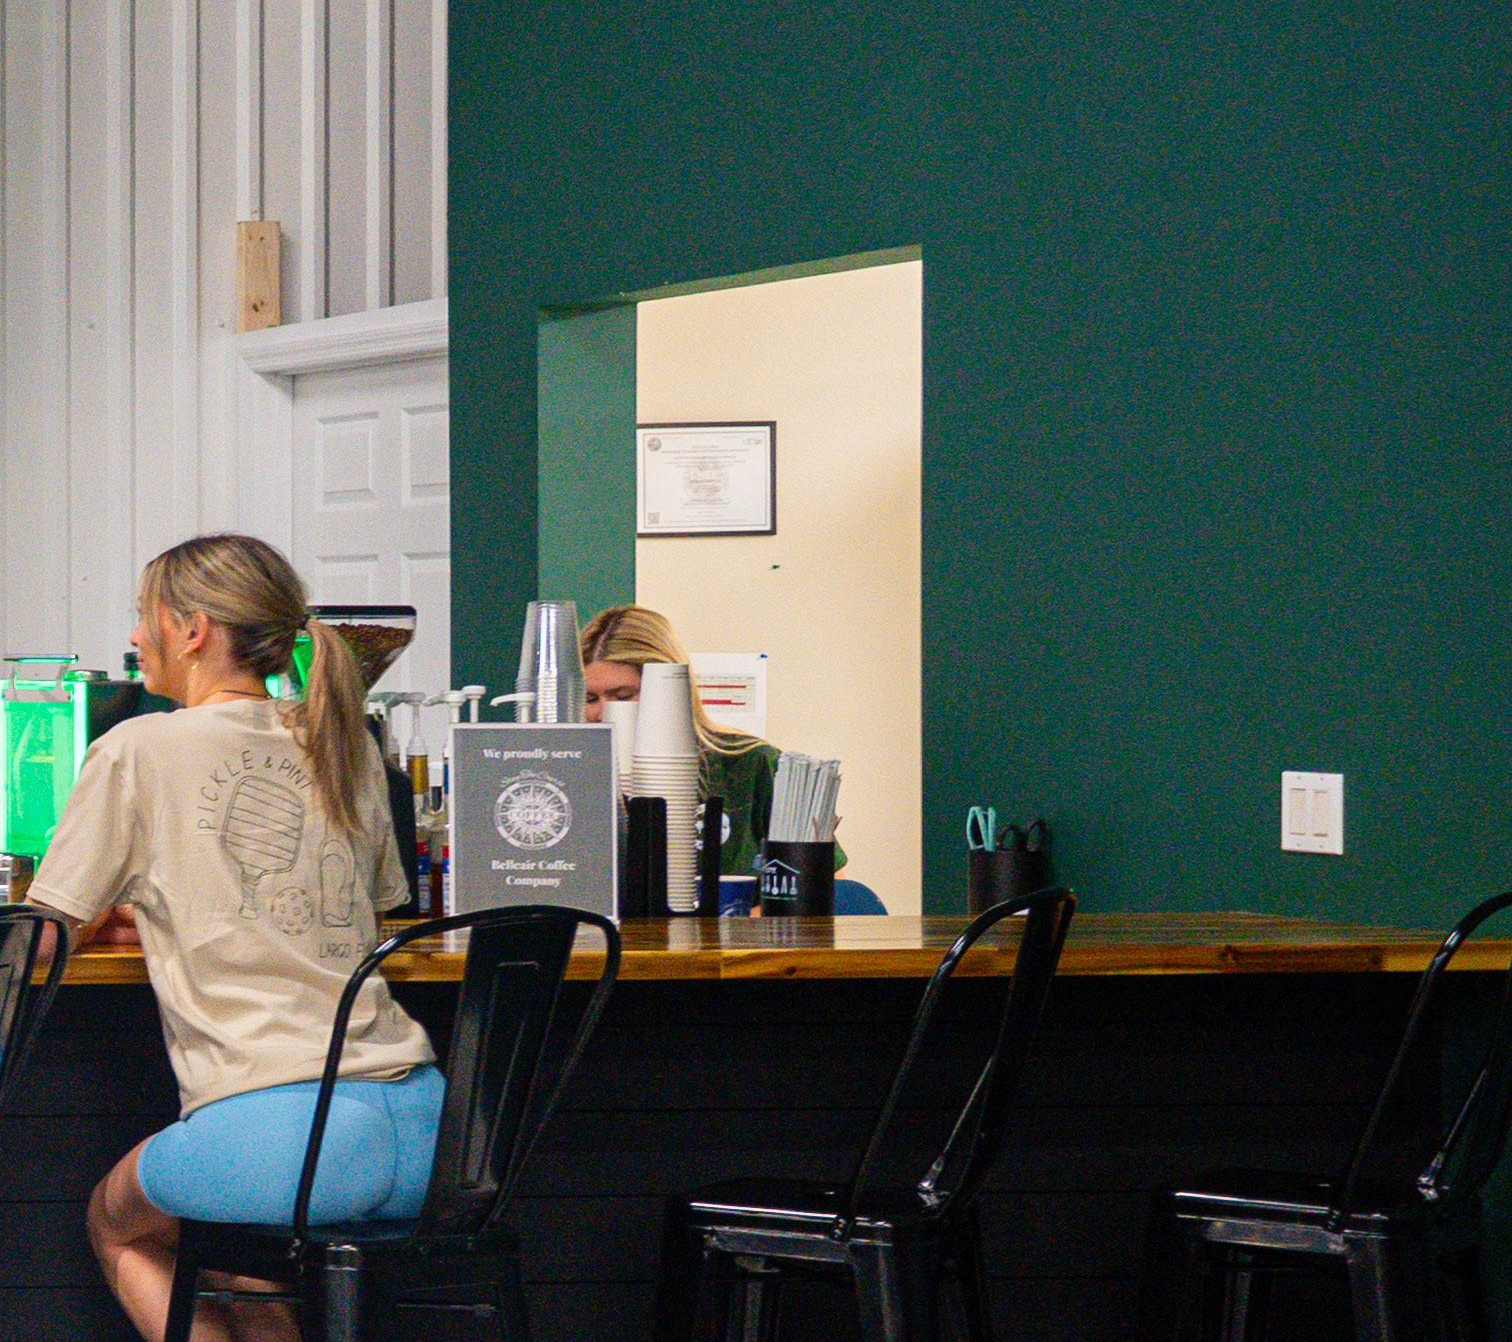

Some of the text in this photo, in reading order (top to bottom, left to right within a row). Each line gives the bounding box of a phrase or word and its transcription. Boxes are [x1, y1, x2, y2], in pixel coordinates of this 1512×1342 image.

[483, 748, 582, 761] We proudly serve
[197, 750, 254, 831] PICKLE
[264, 756, 273, 769] &
[491, 859, 577, 871] Belleair Coffee
[505, 875, 562, 888] Company
